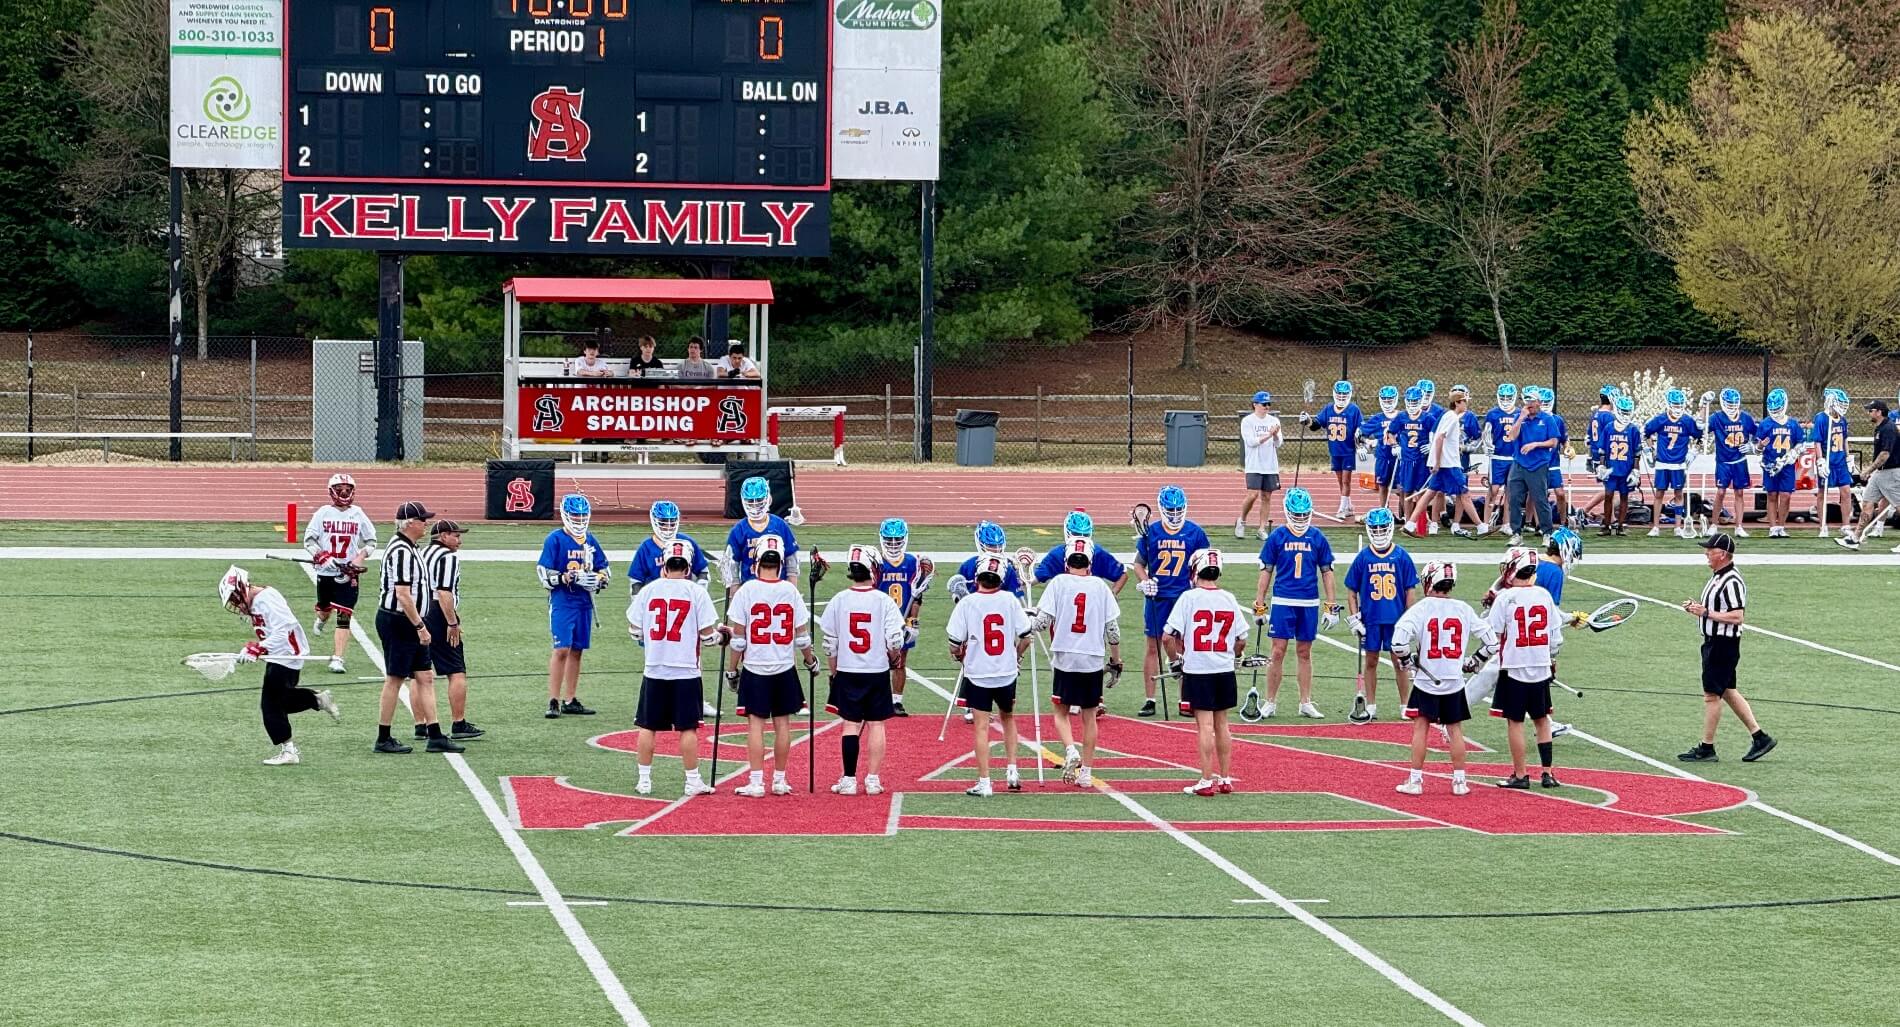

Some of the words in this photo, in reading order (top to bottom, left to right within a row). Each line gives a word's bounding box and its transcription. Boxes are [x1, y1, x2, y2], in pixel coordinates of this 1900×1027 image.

[178, 29, 275, 43] 800-310-1033
[370, 7, 394, 52] 0
[759, 16, 783, 60] 0
[510, 29, 584, 52] PERIOD
[326, 72, 382, 92] DOWN
[426, 74, 450, 93] TO
[455, 75, 481, 95] GO
[742, 81, 787, 101] BALL
[792, 82, 817, 102] ON
[300, 105, 309, 126] 1
[858, 101, 914, 115] J.B.A.
[177, 123, 277, 140] CLEAREDGE
[637, 112, 647, 132] 1
[299, 147, 311, 167] 2
[636, 153, 648, 173] 2
[299, 193, 536, 242] KELLY
[549, 196, 814, 248] FAMILY
[570, 395, 711, 412] ARCHBISHOP
[586, 415, 694, 432] SPALDING
[1327, 424, 1347, 442] 33
[1408, 430, 1419, 448] 2
[1667, 432, 1678, 450] 7
[1772, 435, 1791, 454] 44
[1609, 441, 1629, 461] 32
[322, 520, 359, 535] SPALDING
[329, 535, 352, 559] 17
[1157, 539, 1186, 549] LOYOLA
[1284, 542, 1312, 552] LOYOLA
[1155, 550, 1186, 577] 27
[1294, 552, 1303, 579] 1
[1367, 563, 1396, 573] LOYOLA
[1369, 574, 1397, 601] 36
[648, 598, 691, 642] 37
[1070, 592, 1088, 634] 1
[750, 603, 794, 646] 23
[848, 612, 872, 654] 5
[982, 613, 1005, 656] 6
[1192, 609, 1235, 653] 27
[1513, 605, 1549, 648] 12
[1426, 617, 1463, 660] 13
